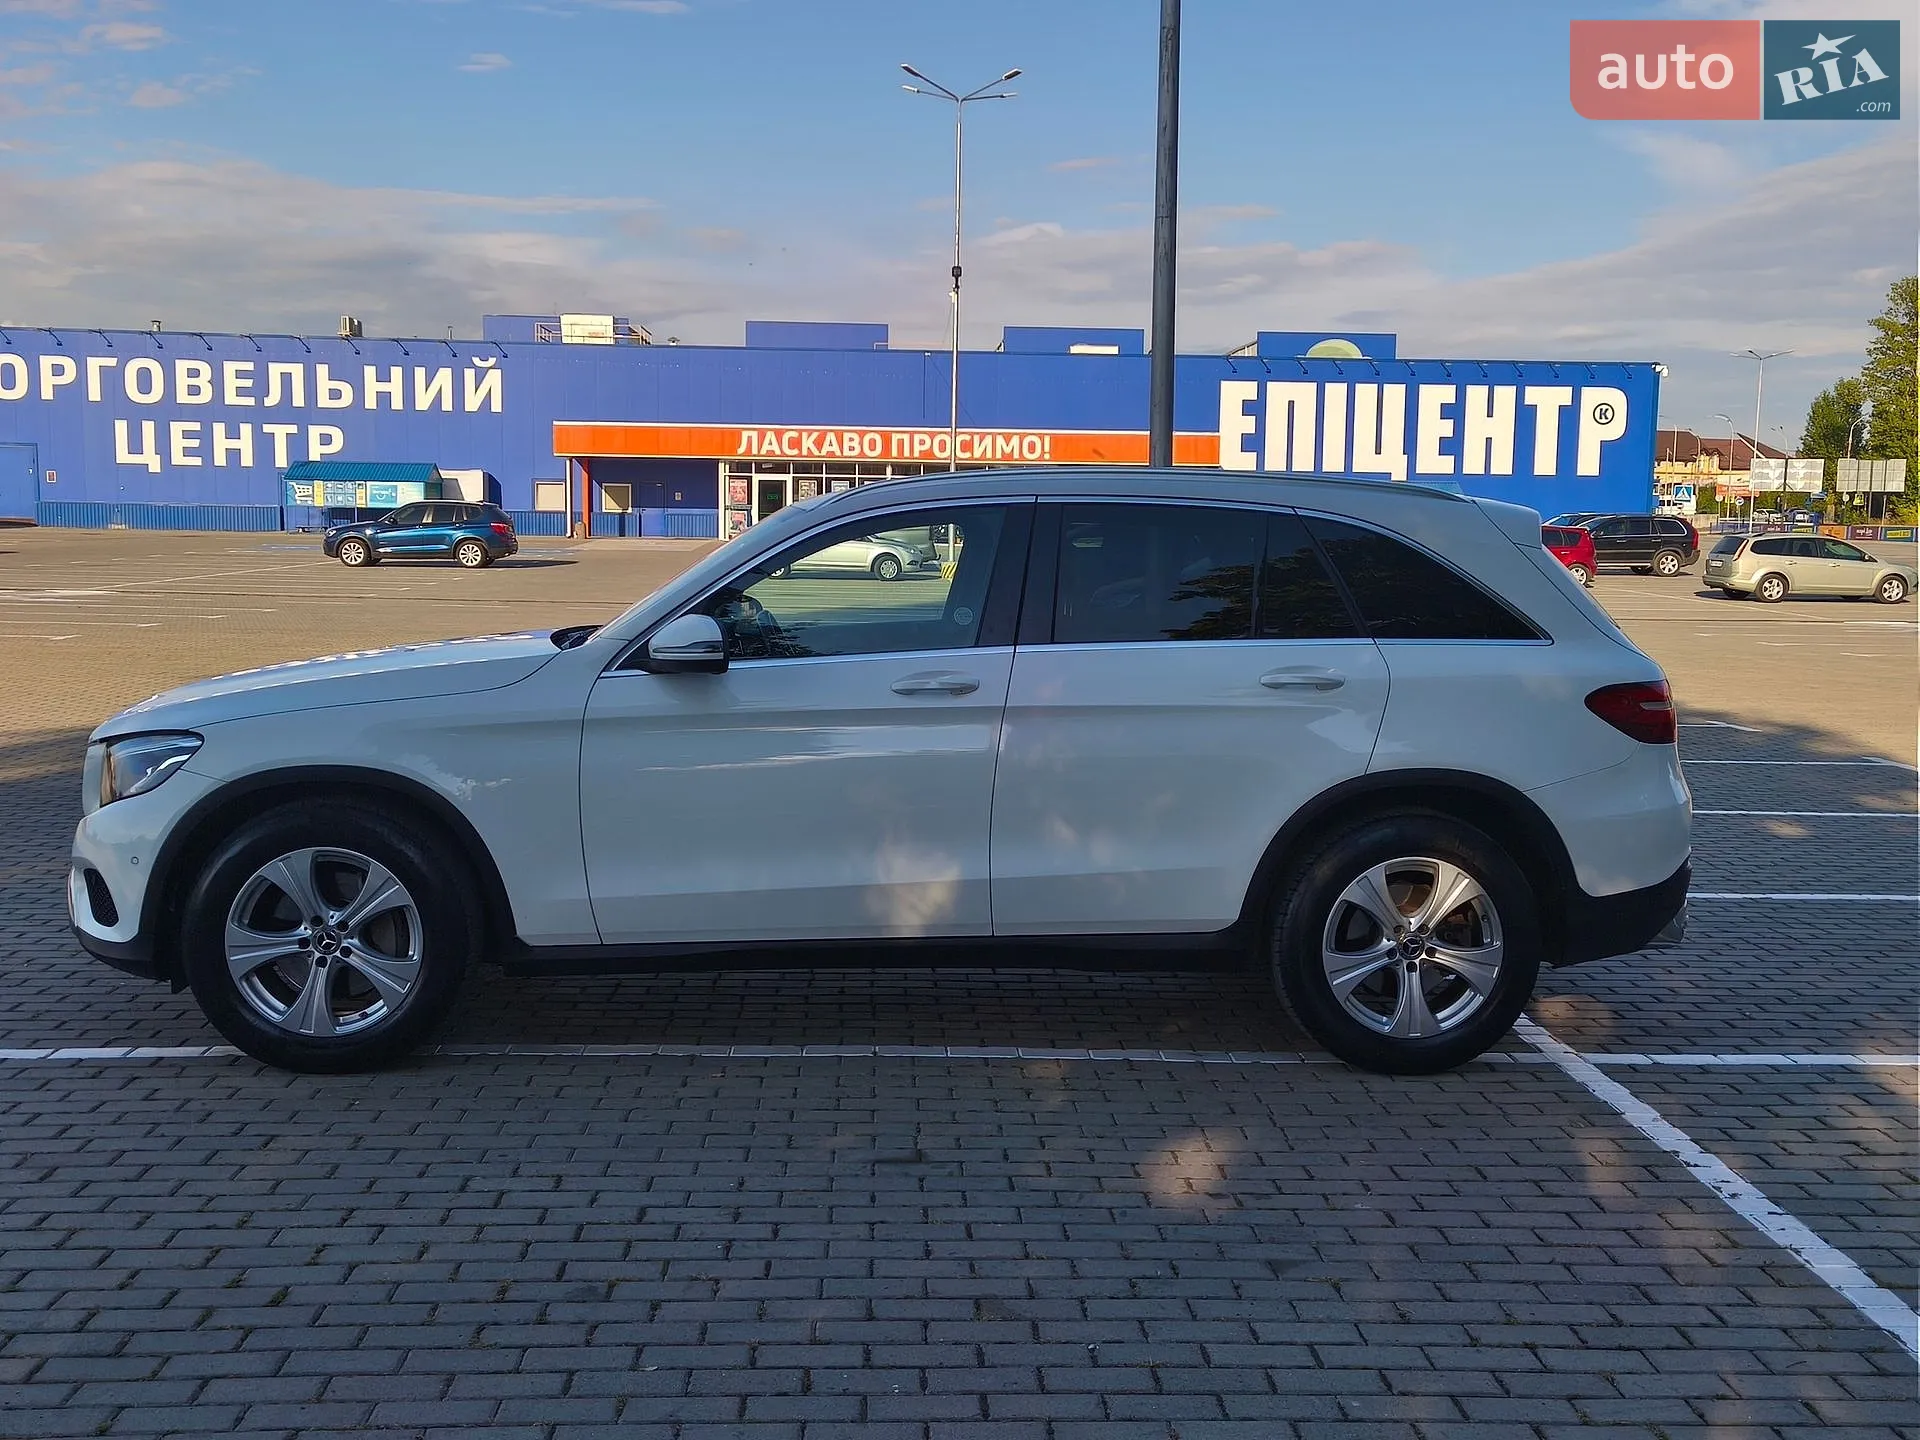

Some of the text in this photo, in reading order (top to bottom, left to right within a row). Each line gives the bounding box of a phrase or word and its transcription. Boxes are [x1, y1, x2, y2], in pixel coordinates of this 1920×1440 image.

[114, 419, 345, 473] ЦЕНТР
[736, 430, 1051, 461] ЛАСКАВО ПРОСИМО!
[1220, 380, 1628, 481] ЕПІЦЕНТР
